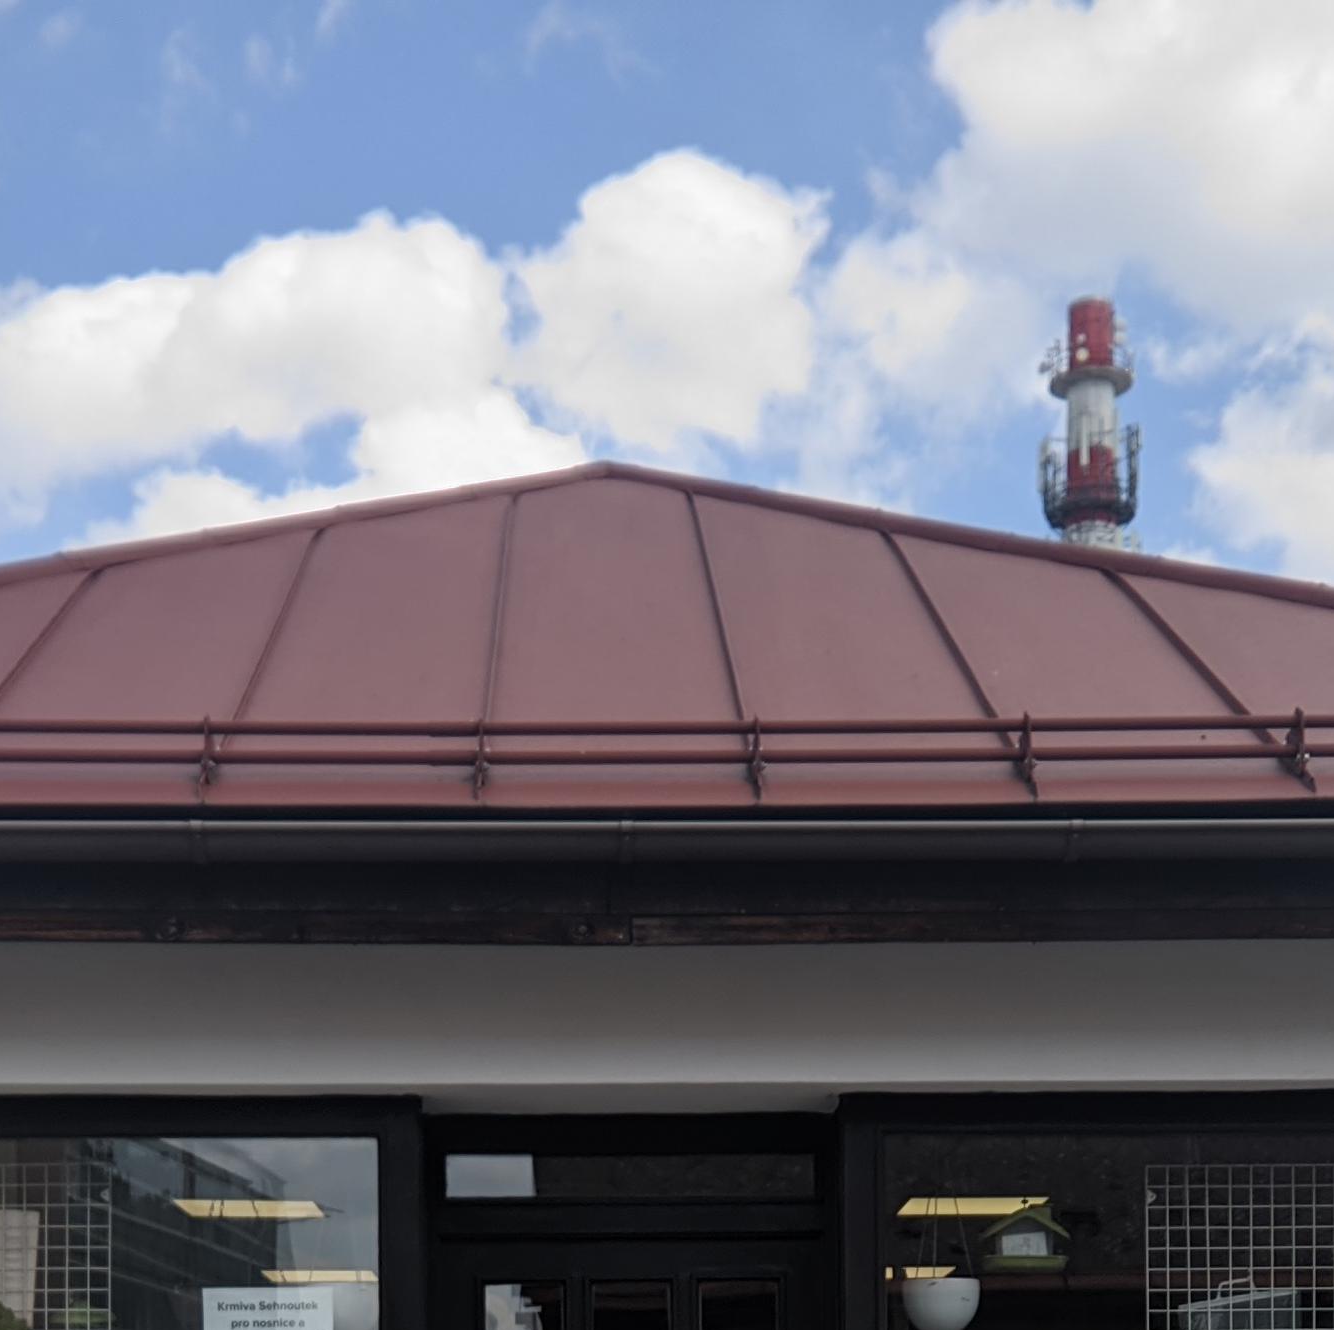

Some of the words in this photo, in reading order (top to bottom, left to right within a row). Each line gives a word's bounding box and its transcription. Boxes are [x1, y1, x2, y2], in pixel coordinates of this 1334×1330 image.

[217, 1301, 256, 1311] Krmiva
[231, 1320, 250, 1330] pro
[253, 1319, 296, 1328] nosnice
